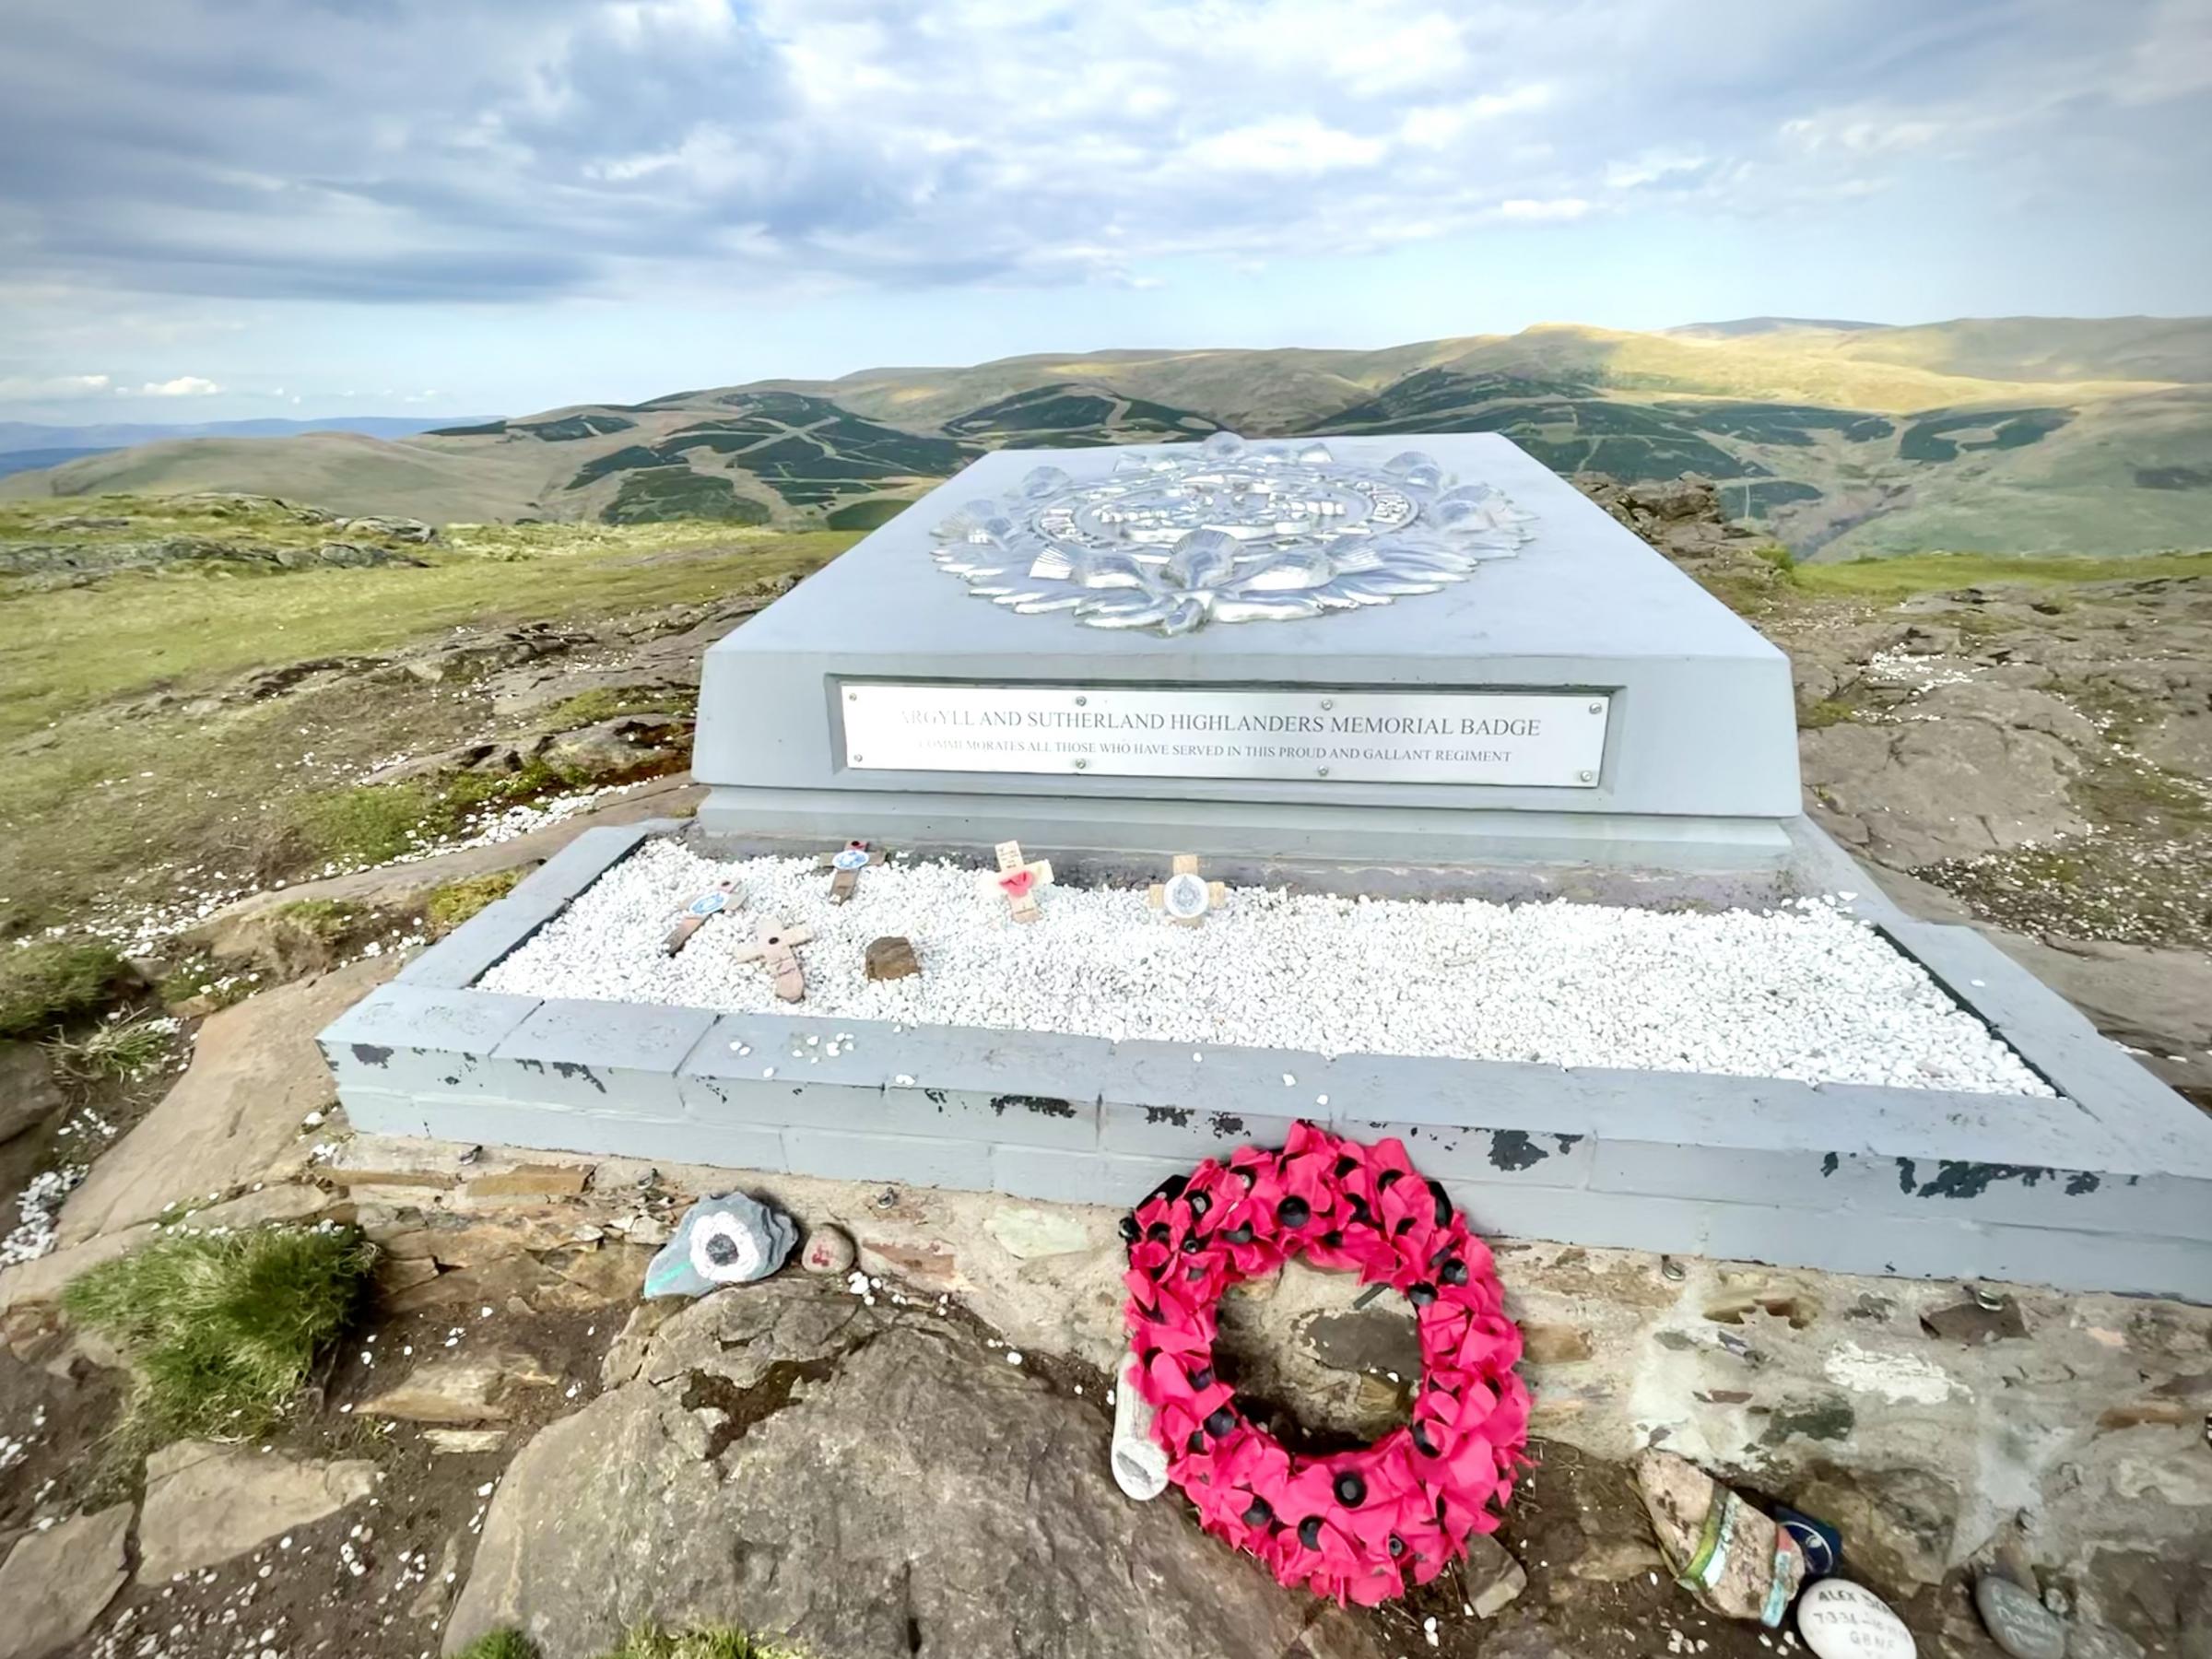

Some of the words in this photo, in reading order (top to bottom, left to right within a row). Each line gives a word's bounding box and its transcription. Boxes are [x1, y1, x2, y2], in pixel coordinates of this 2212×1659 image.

[979, 712, 1021, 727] AND
[1027, 712, 1165, 730] SUTHERLAND
[1171, 714, 1324, 734] HIGHLANDERS
[1330, 717, 1453, 735] MEMORIAL
[1460, 719, 1541, 736] BADGE
[1027, 741, 1052, 753] ALL
[1053, 742, 1097, 754] THOSE
[1100, 743, 1132, 755] WHO
[1134, 744, 1170, 756] HAVE
[1171, 745, 1224, 757] SERVED
[1227, 746, 1241, 756] IN
[1245, 746, 1276, 758] THIS
[1279, 747, 1326, 759] PROUD
[1328, 747, 1360, 759] AND
[1363, 748, 1431, 761] GALLANT
[1435, 750, 1512, 763] REGIMENT
[1818, 1589, 1857, 1603] ALEX
